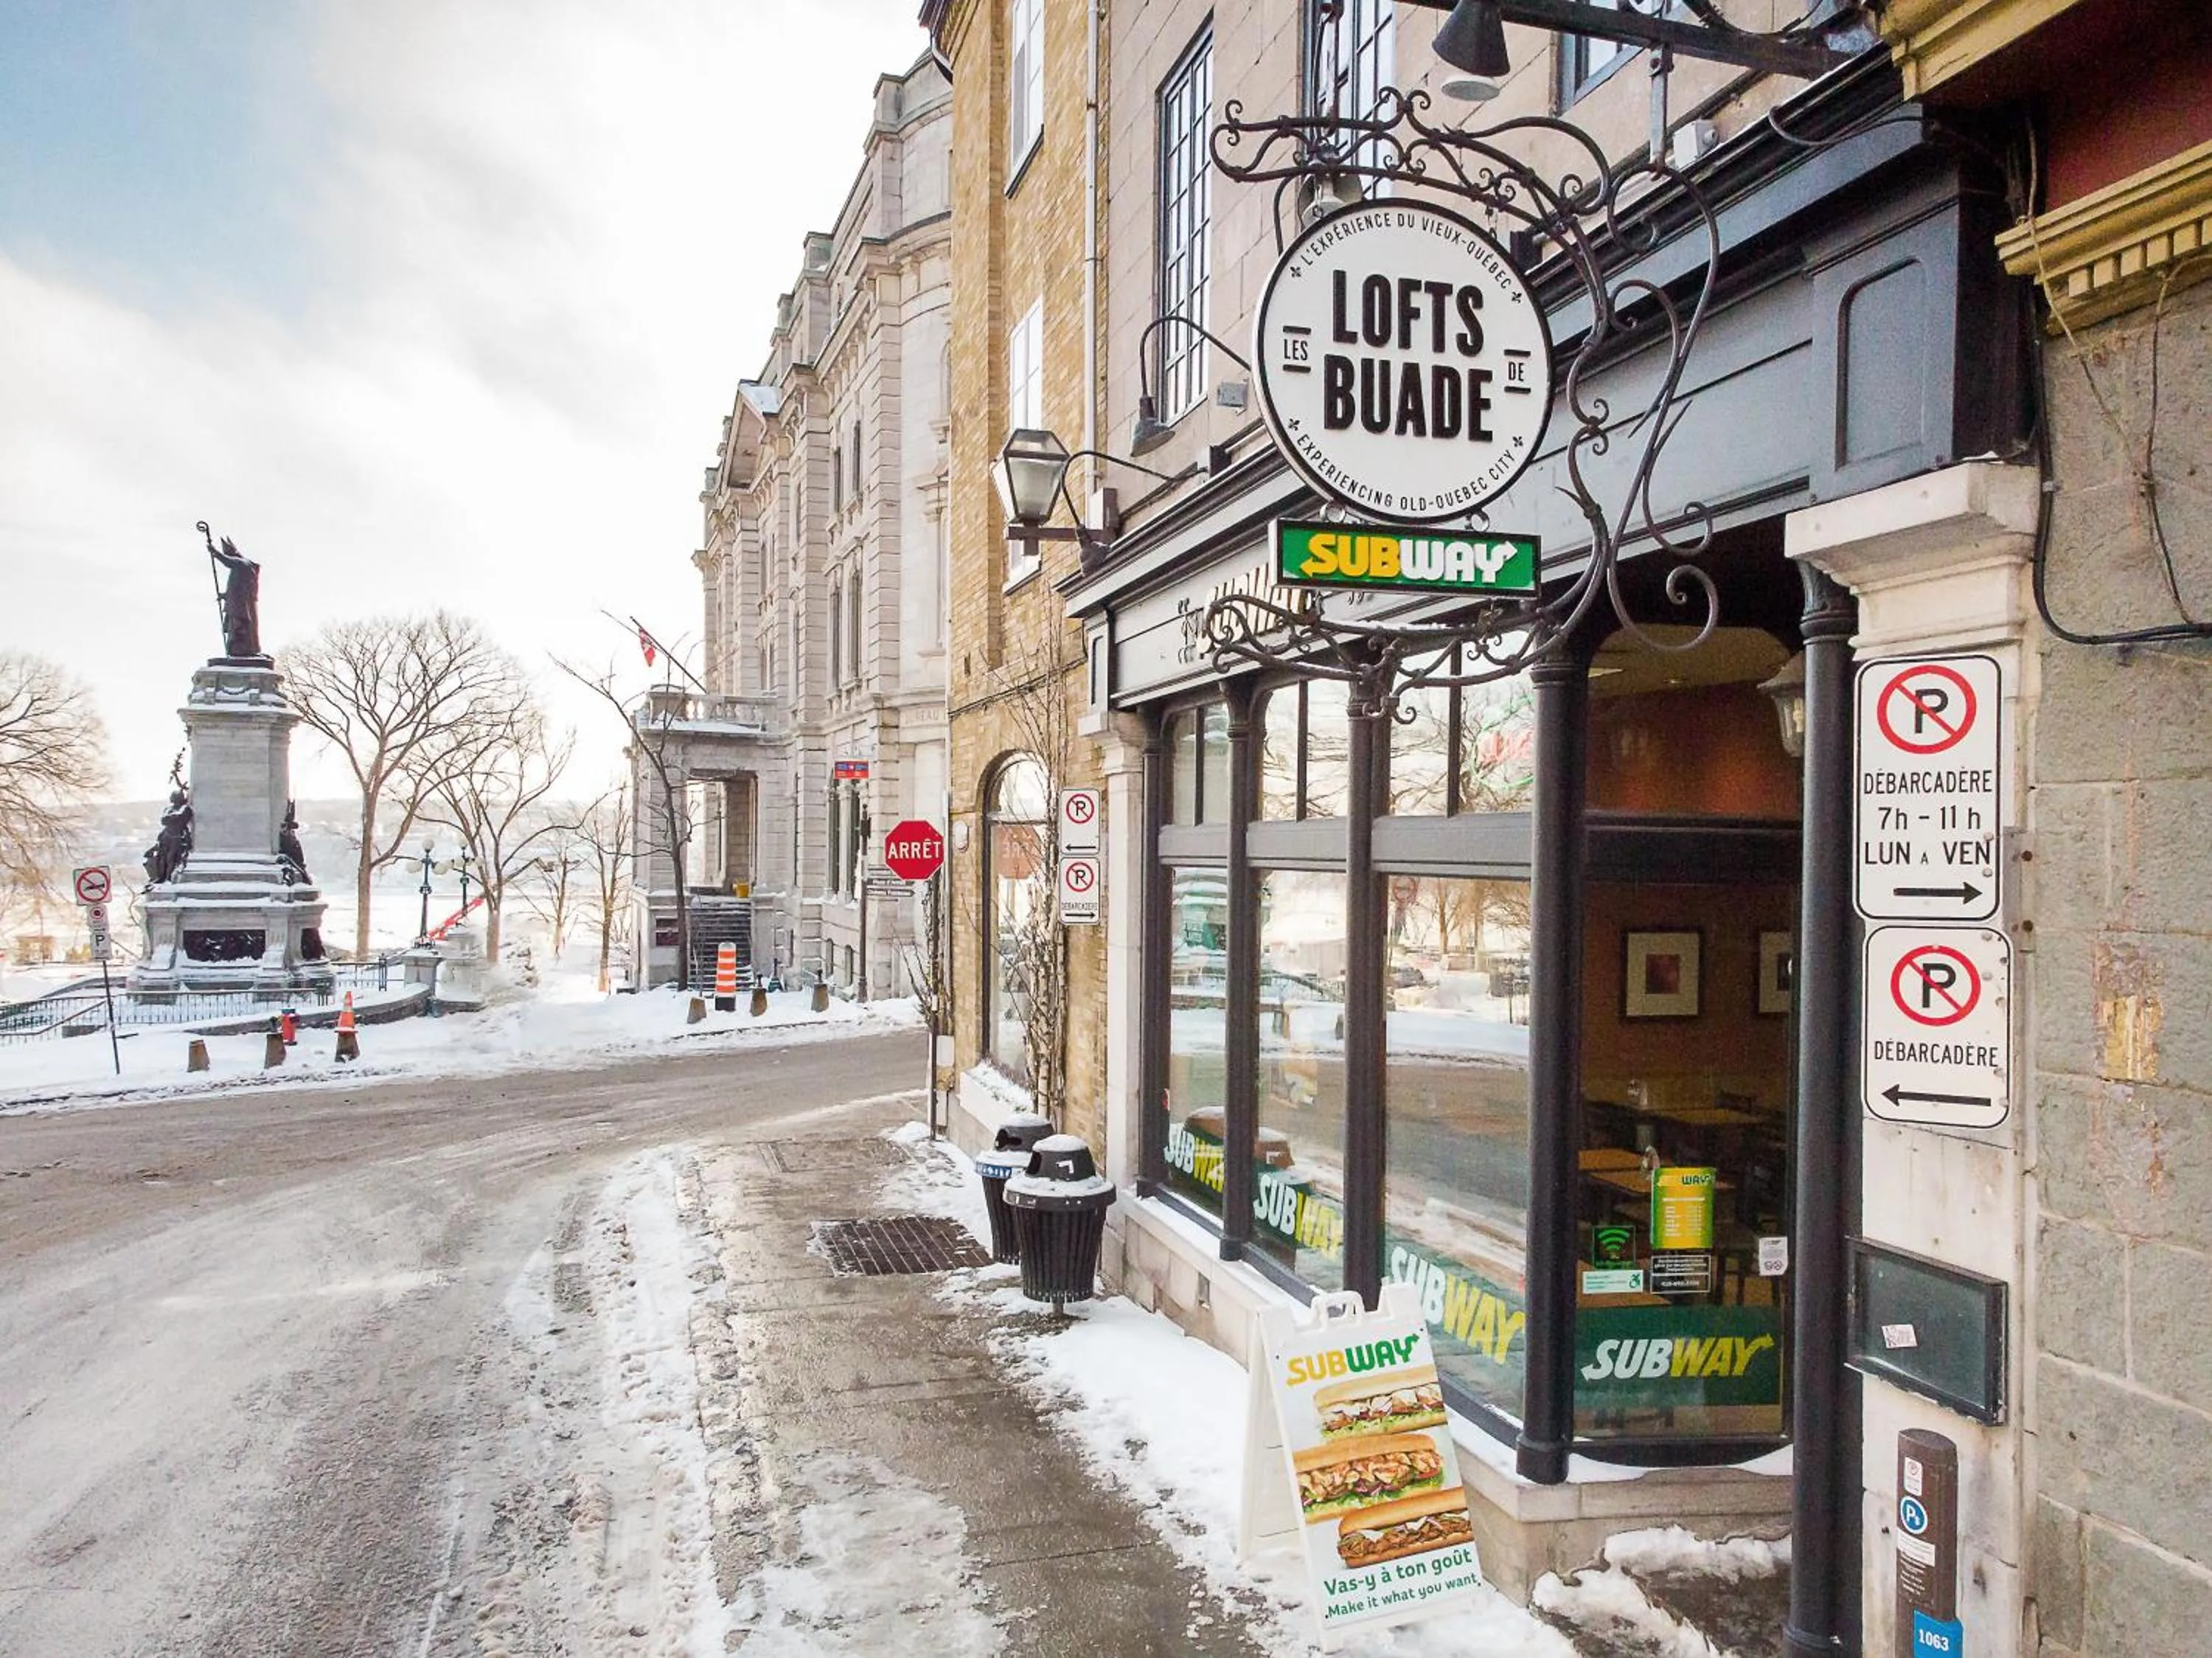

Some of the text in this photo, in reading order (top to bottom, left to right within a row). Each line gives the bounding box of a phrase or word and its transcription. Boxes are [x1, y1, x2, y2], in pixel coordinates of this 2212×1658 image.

[1301, 212, 1512, 289] L'EXPÉRIENCE DU VIEUX-QUÉBEC
[1332, 270, 1484, 357] LOFTS
[1283, 339, 1309, 361] LES
[1508, 361, 1525, 382] DE
[1324, 354, 1493, 442] BUADE
[1297, 434, 1393, 507] EXPERIENCING
[1489, 449, 1516, 481] CITY
[1300, 533, 1518, 583] SUBWAY
[1864, 765, 1992, 794] DÉBARCADÈRE
[887, 838, 941, 859] ARRÊT
[1865, 842, 1910, 864] LUN
[1942, 842, 1990, 865] VEN
[1874, 1037, 1999, 1067] DÉBARCADÈRE
[1286, 1333, 1419, 1386] SUBWAY
[1581, 1334, 1774, 1381] SUBWAY
[1324, 1548, 1472, 1596] Vas-y à ton goût
[1327, 1572, 1478, 1617] Make it what you want
[1919, 1628, 1950, 1651] 1063
